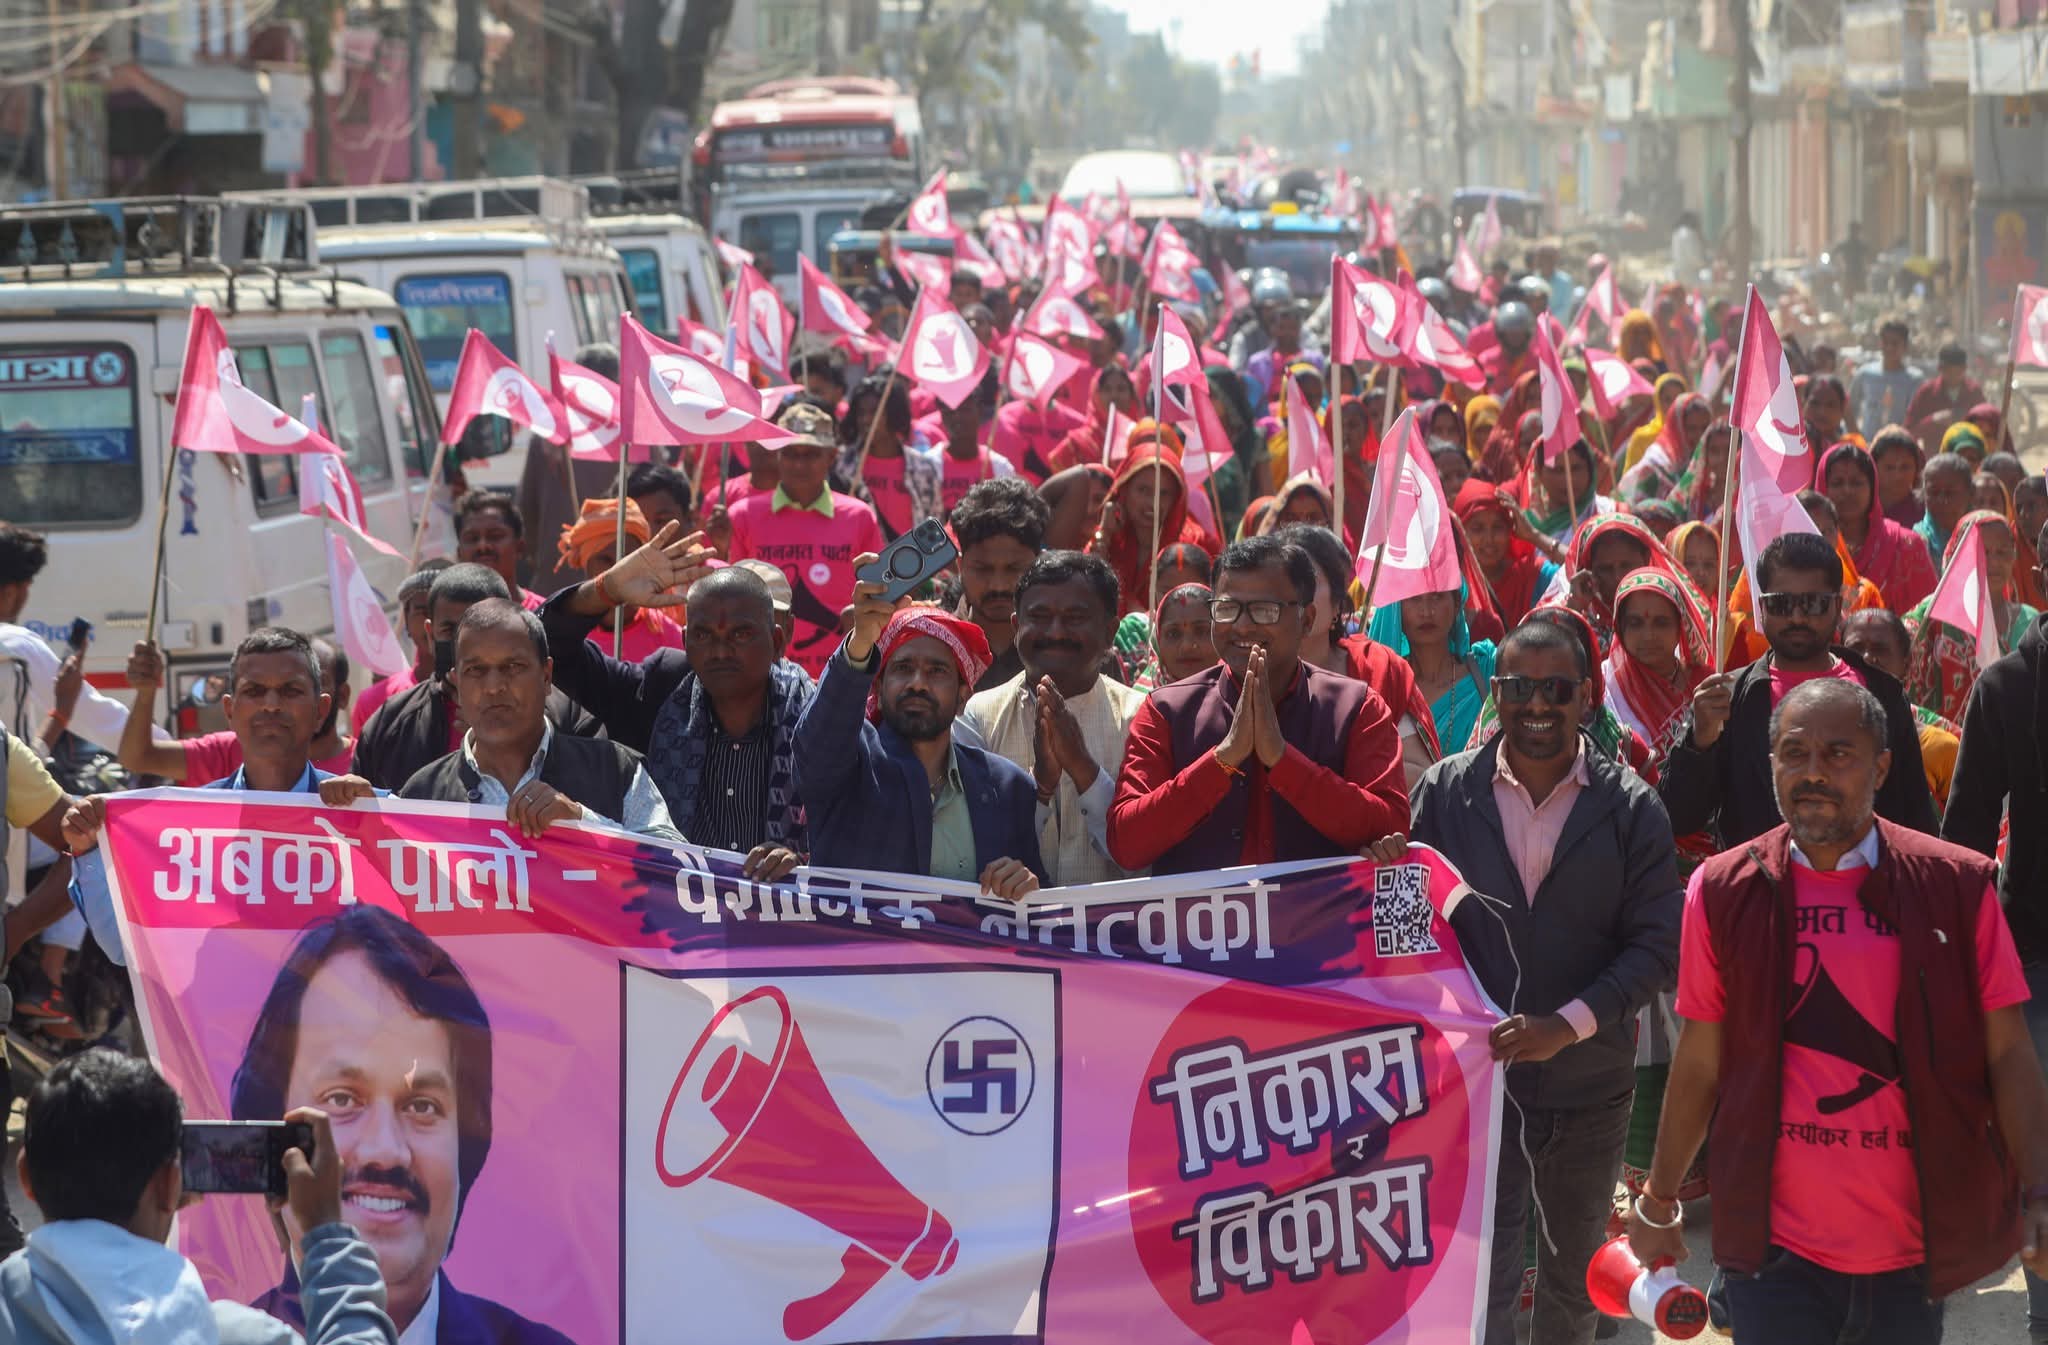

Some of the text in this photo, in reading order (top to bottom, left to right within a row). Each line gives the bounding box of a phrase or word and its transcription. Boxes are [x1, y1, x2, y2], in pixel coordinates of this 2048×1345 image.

[154, 816, 361, 904] अबको
[377, 828, 537, 913] पालो
[1156, 1026, 1423, 1174] निकास
[1346, 1133, 1369, 1160] र
[1178, 1163, 1427, 1297] विकास
